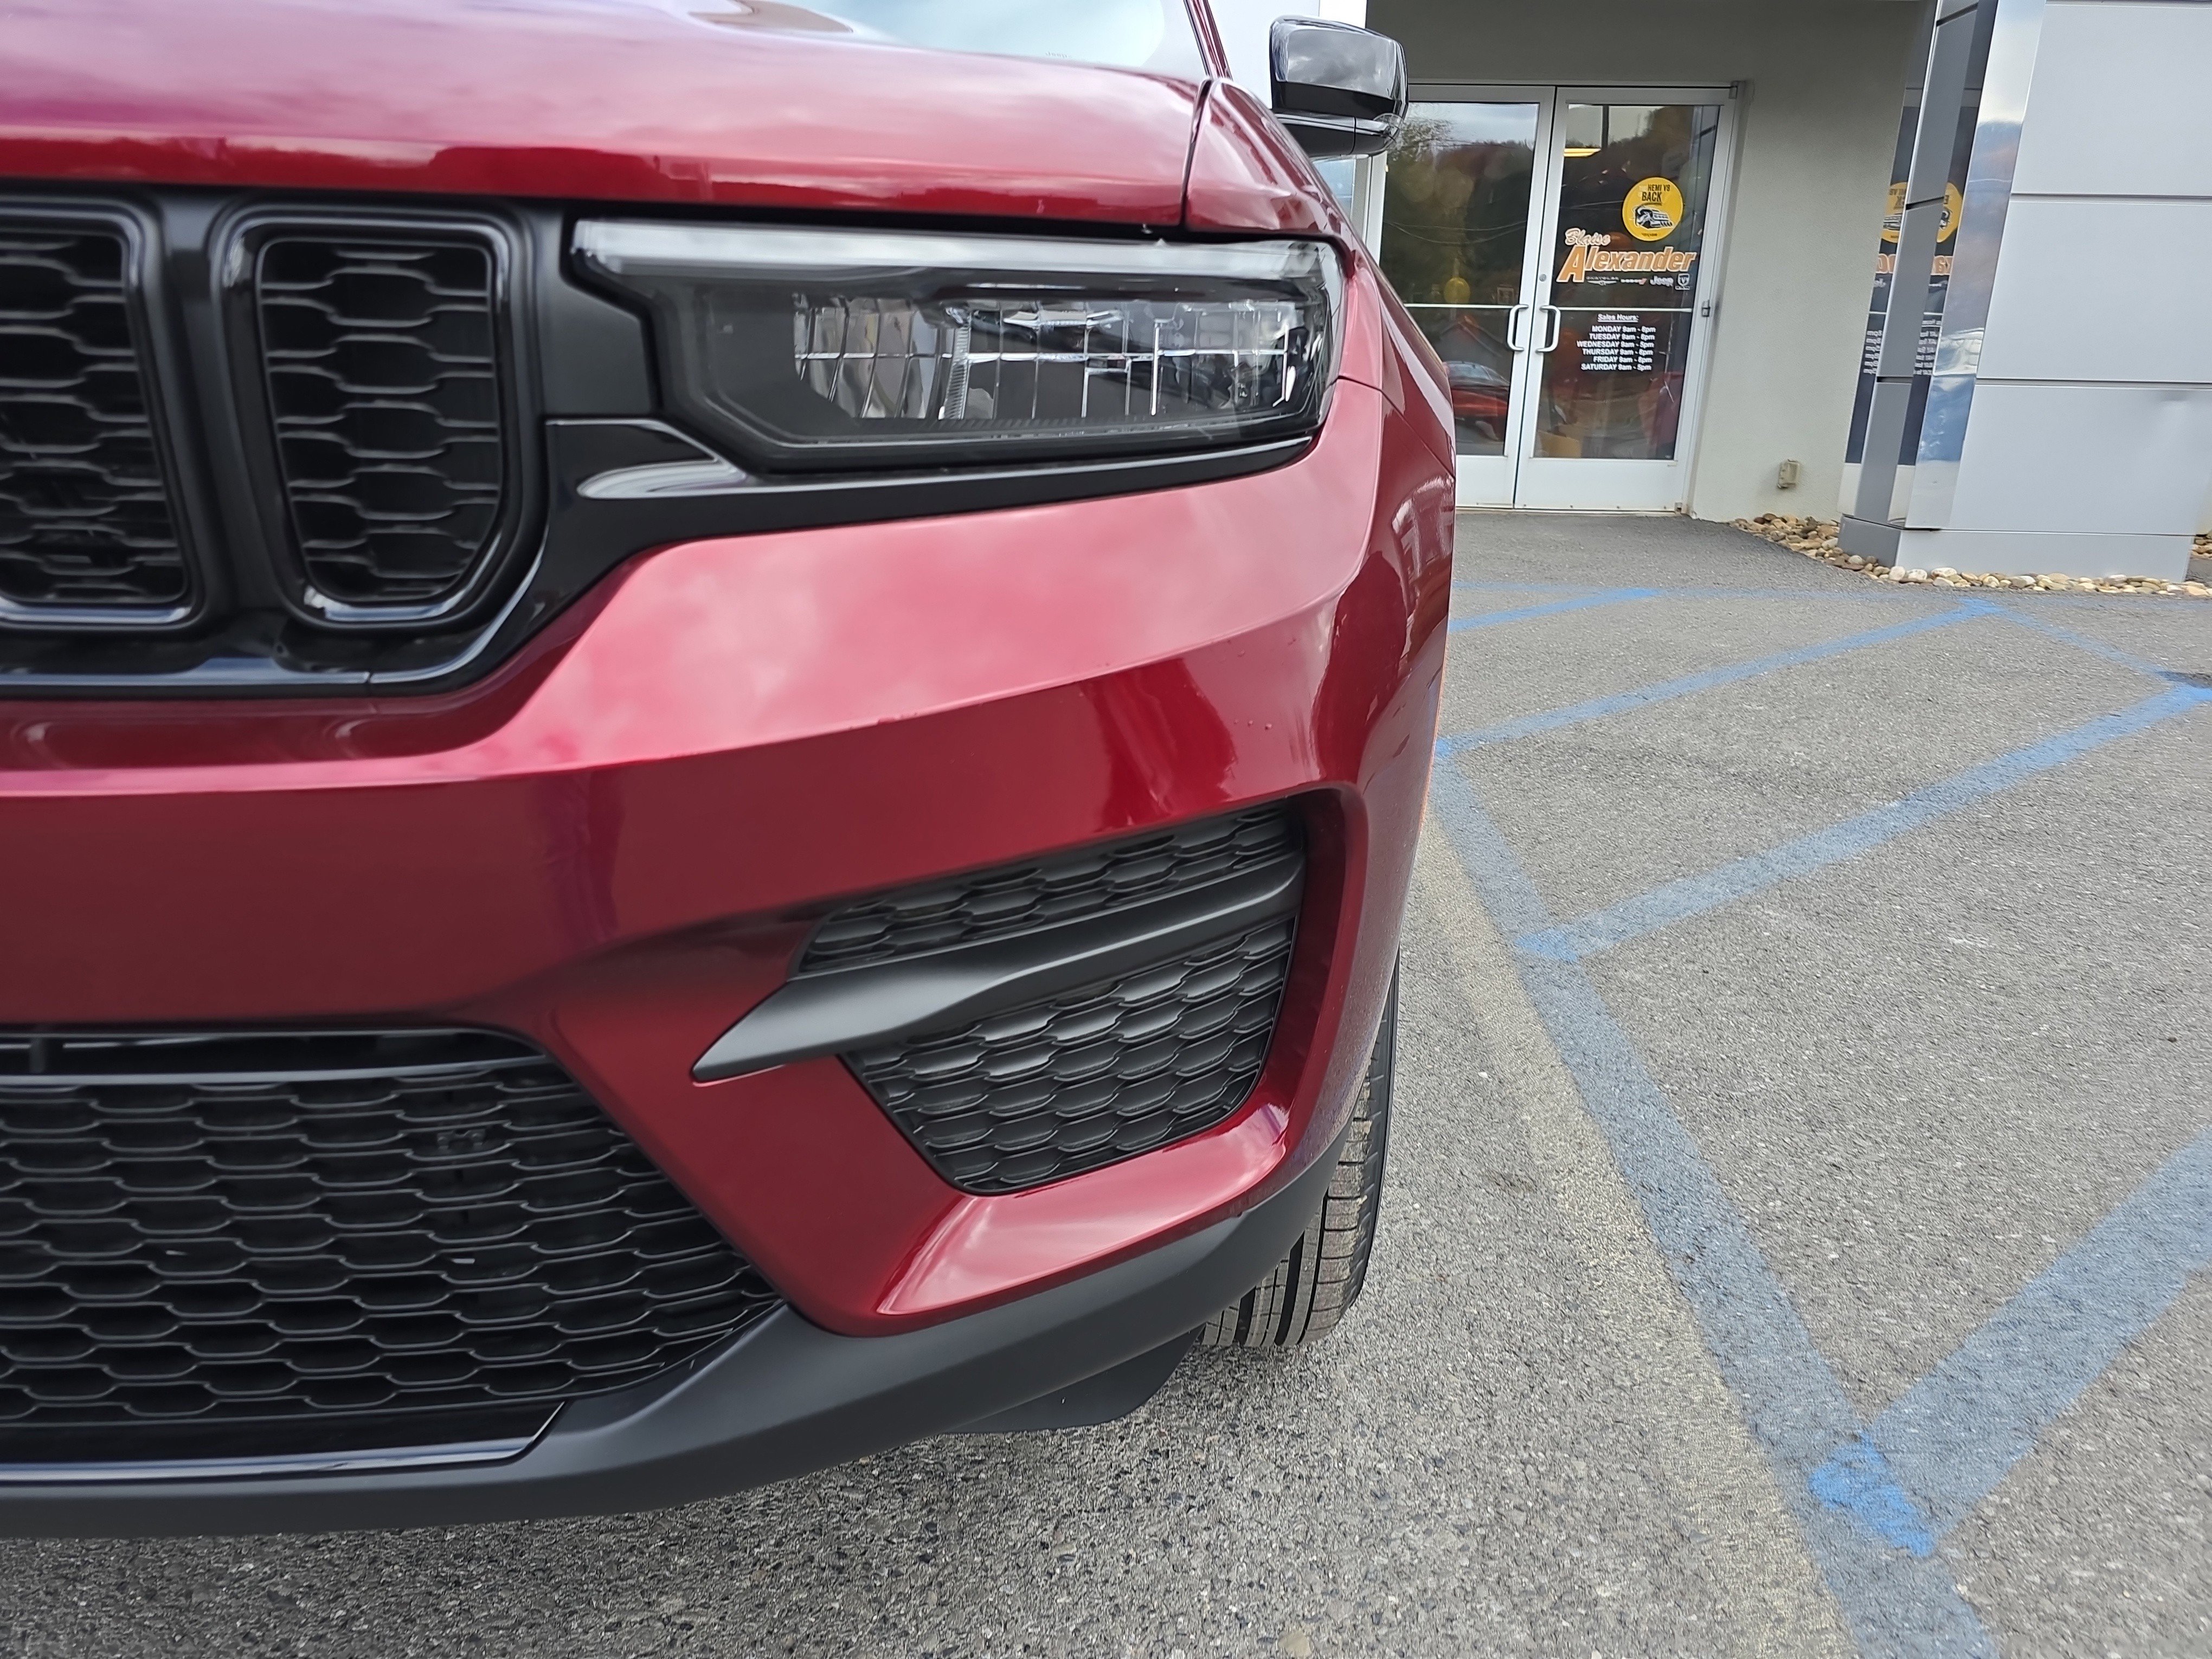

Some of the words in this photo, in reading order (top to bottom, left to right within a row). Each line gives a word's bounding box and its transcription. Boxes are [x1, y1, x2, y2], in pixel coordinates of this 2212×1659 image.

[1642, 191, 1662, 202] BACK
[1565, 228, 1610, 246] Blaise
[1556, 245, 1696, 282] Alexander
